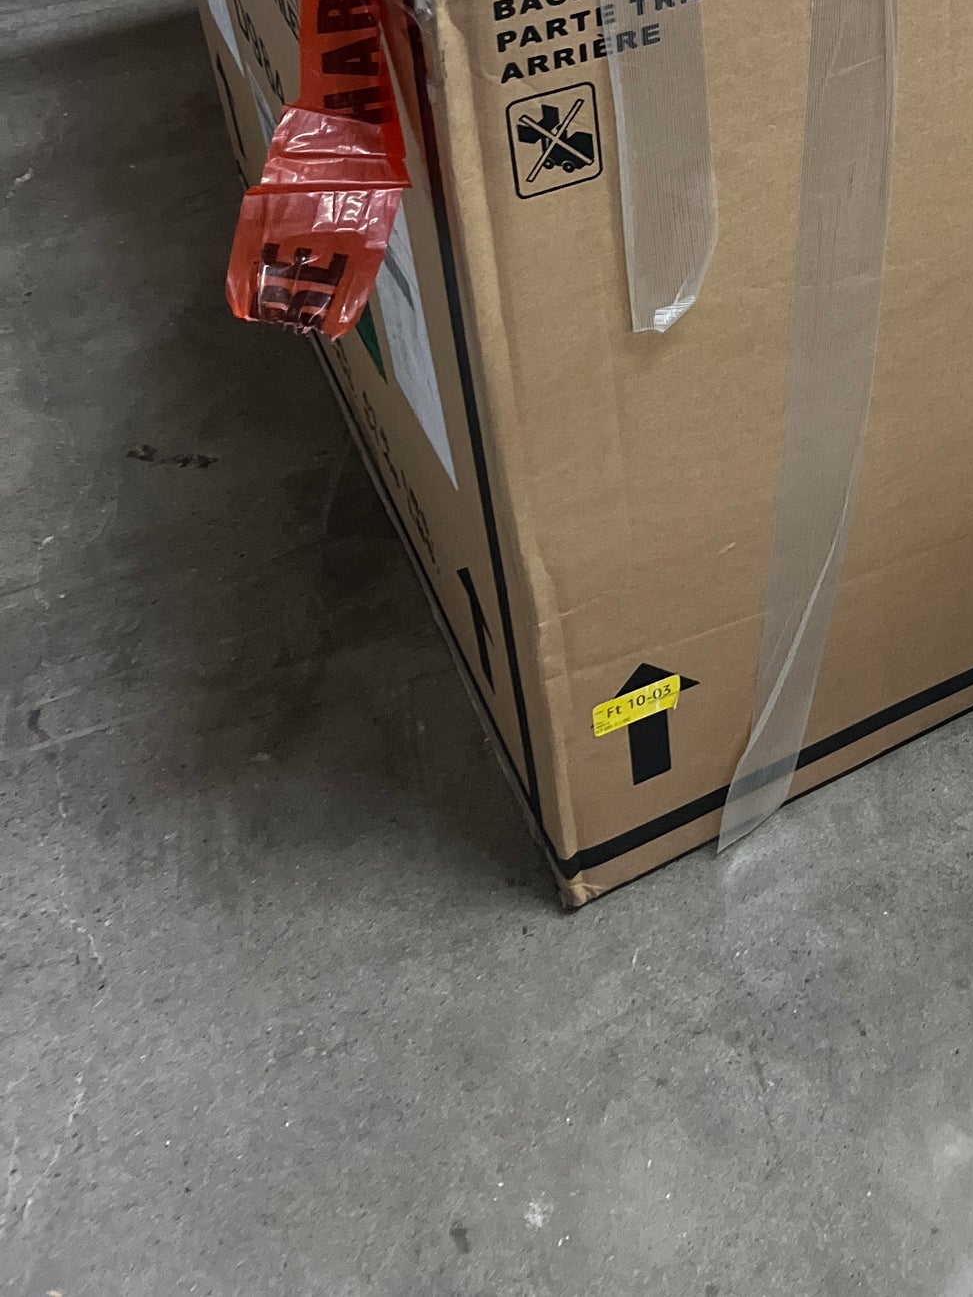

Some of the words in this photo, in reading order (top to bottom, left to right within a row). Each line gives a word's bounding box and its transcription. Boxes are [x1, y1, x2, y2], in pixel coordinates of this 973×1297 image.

[496, 3, 616, 53] PARTE
[501, 23, 662, 84] ARRIÈRE
[606, 704, 623, 719] Ft
[627, 684, 672, 710] 10-03
